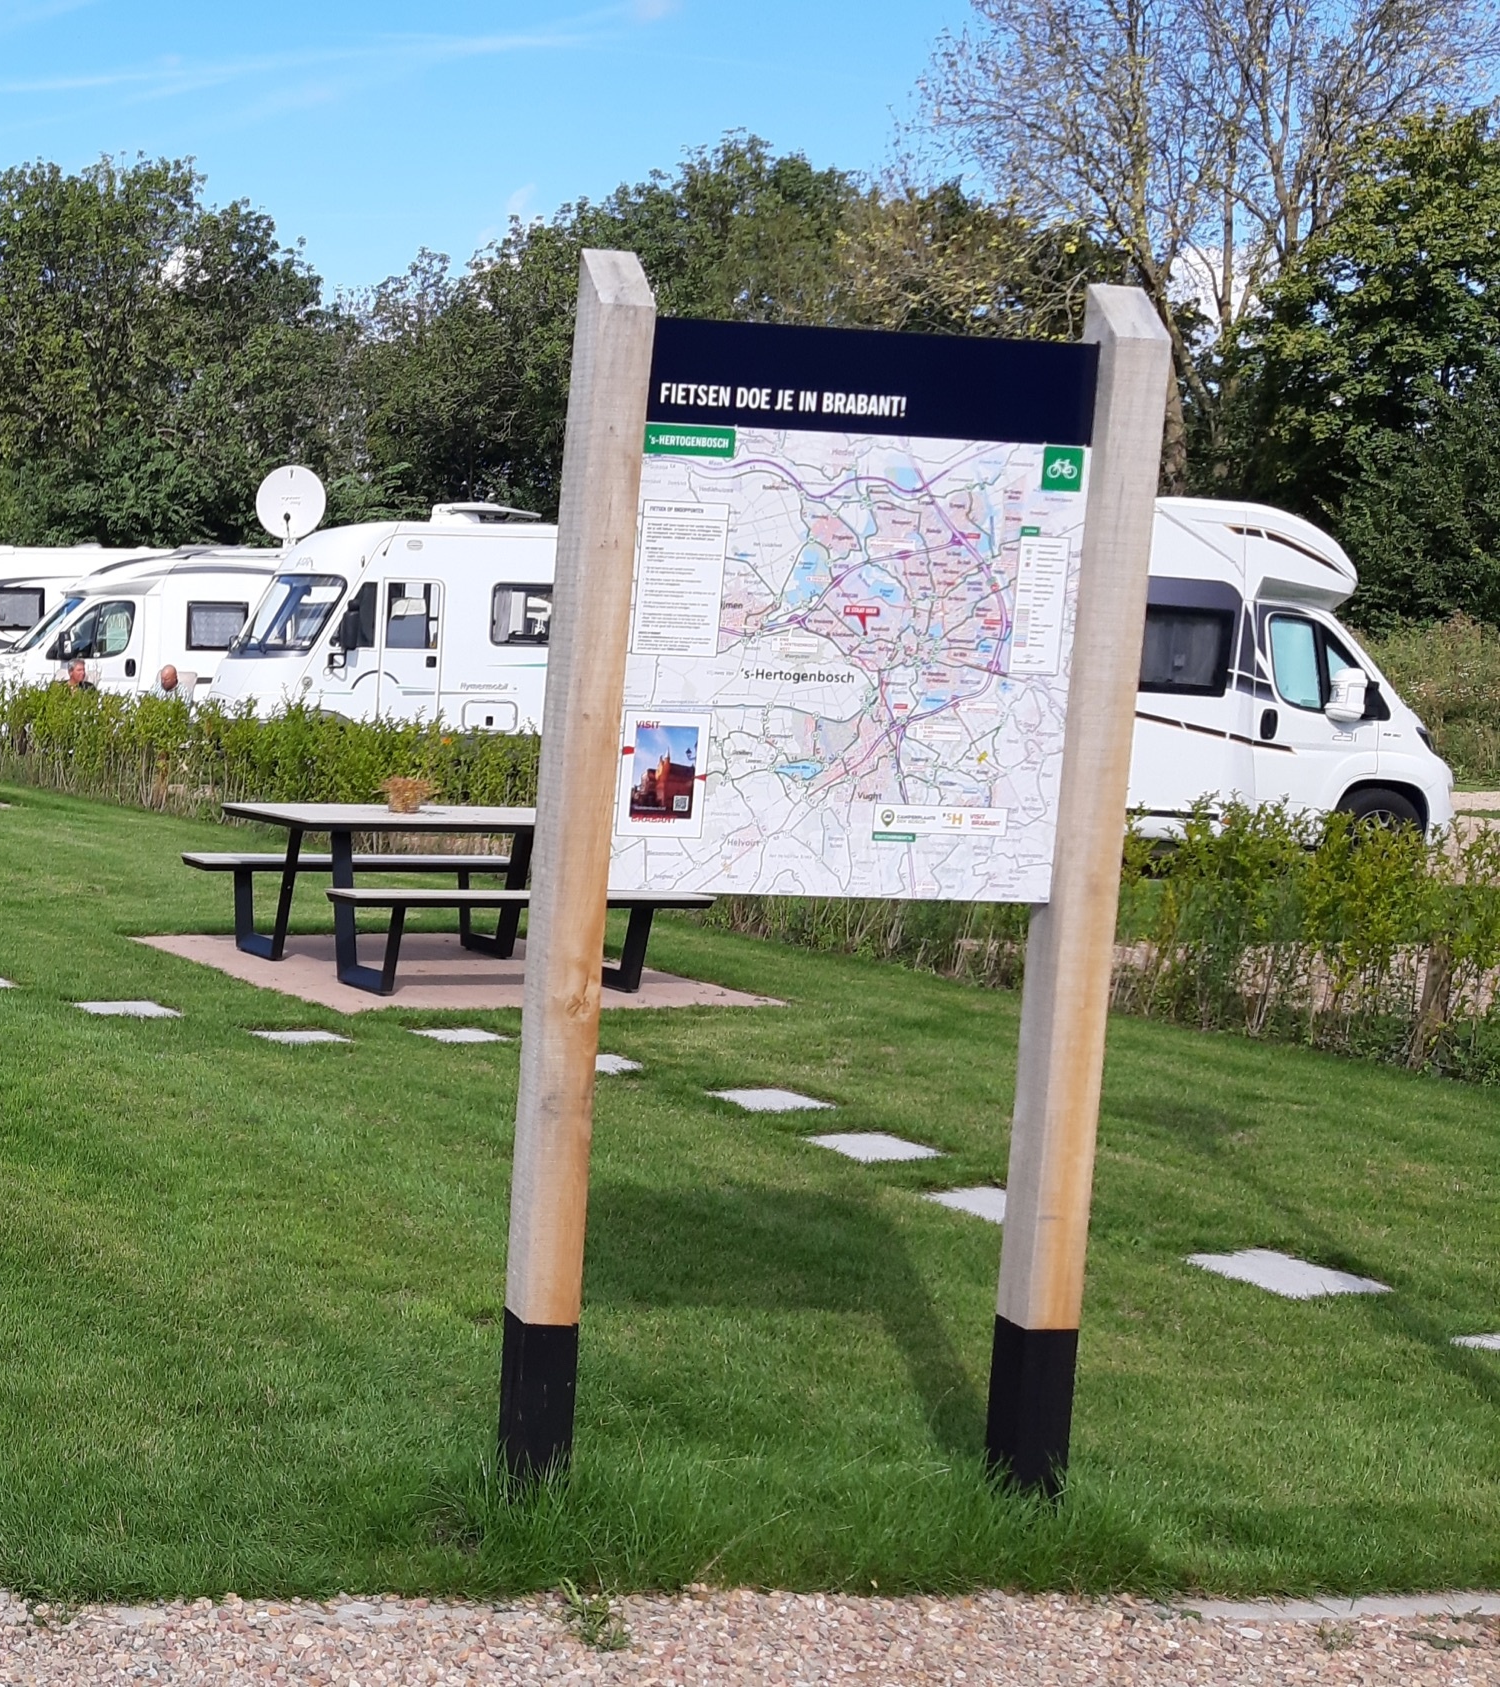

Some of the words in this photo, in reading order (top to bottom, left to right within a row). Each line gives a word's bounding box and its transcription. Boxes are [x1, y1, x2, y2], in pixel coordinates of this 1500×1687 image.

[660, 382, 731, 407] FIETSEN
[735, 386, 771, 409] DOE
[774, 389, 794, 411] JE
[798, 390, 817, 412] IN
[821, 391, 907, 417] BRABANT!
[649, 434, 729, 449] 's-HERTOGENBOSCH
[740, 667, 856, 685] 's-Hertogenbosch
[635, 720, 661, 730] VISIT
[857, 790, 882, 802] Vught
